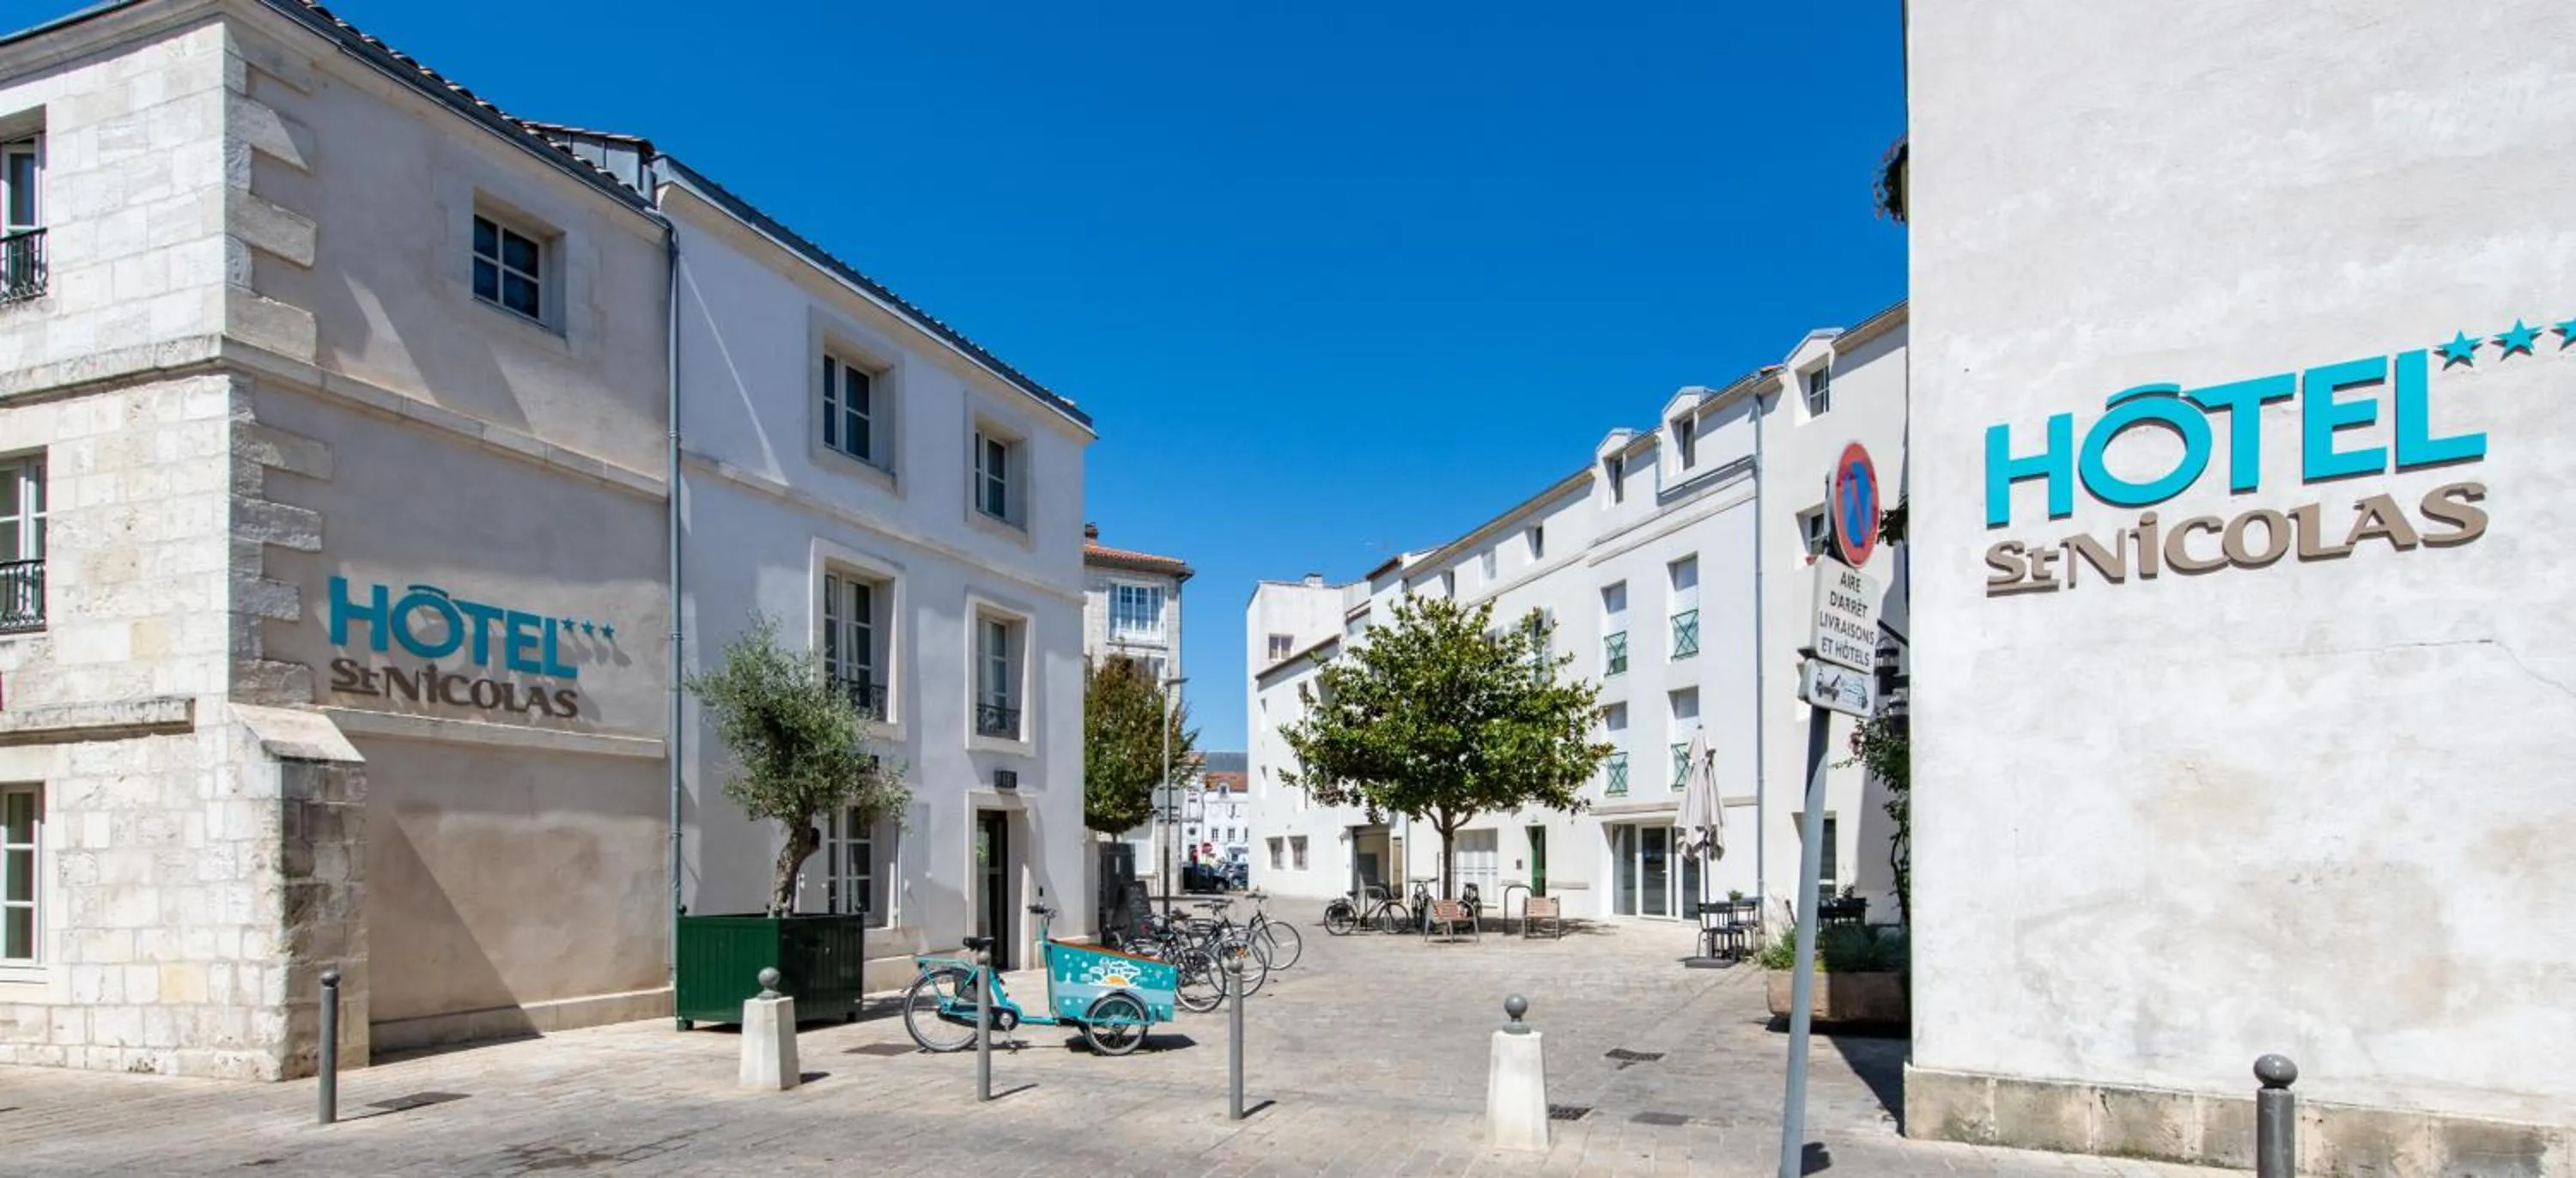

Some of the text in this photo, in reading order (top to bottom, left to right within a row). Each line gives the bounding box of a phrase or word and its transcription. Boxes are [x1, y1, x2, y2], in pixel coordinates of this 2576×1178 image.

[1984, 348, 2488, 530] HÔTEL
[1840, 572, 1862, 593] AIRE
[329, 576, 578, 679] HÔTEL
[1820, 610, 1874, 646] LIVRAISONS
[1821, 636, 1869, 667] ET HÔTELS
